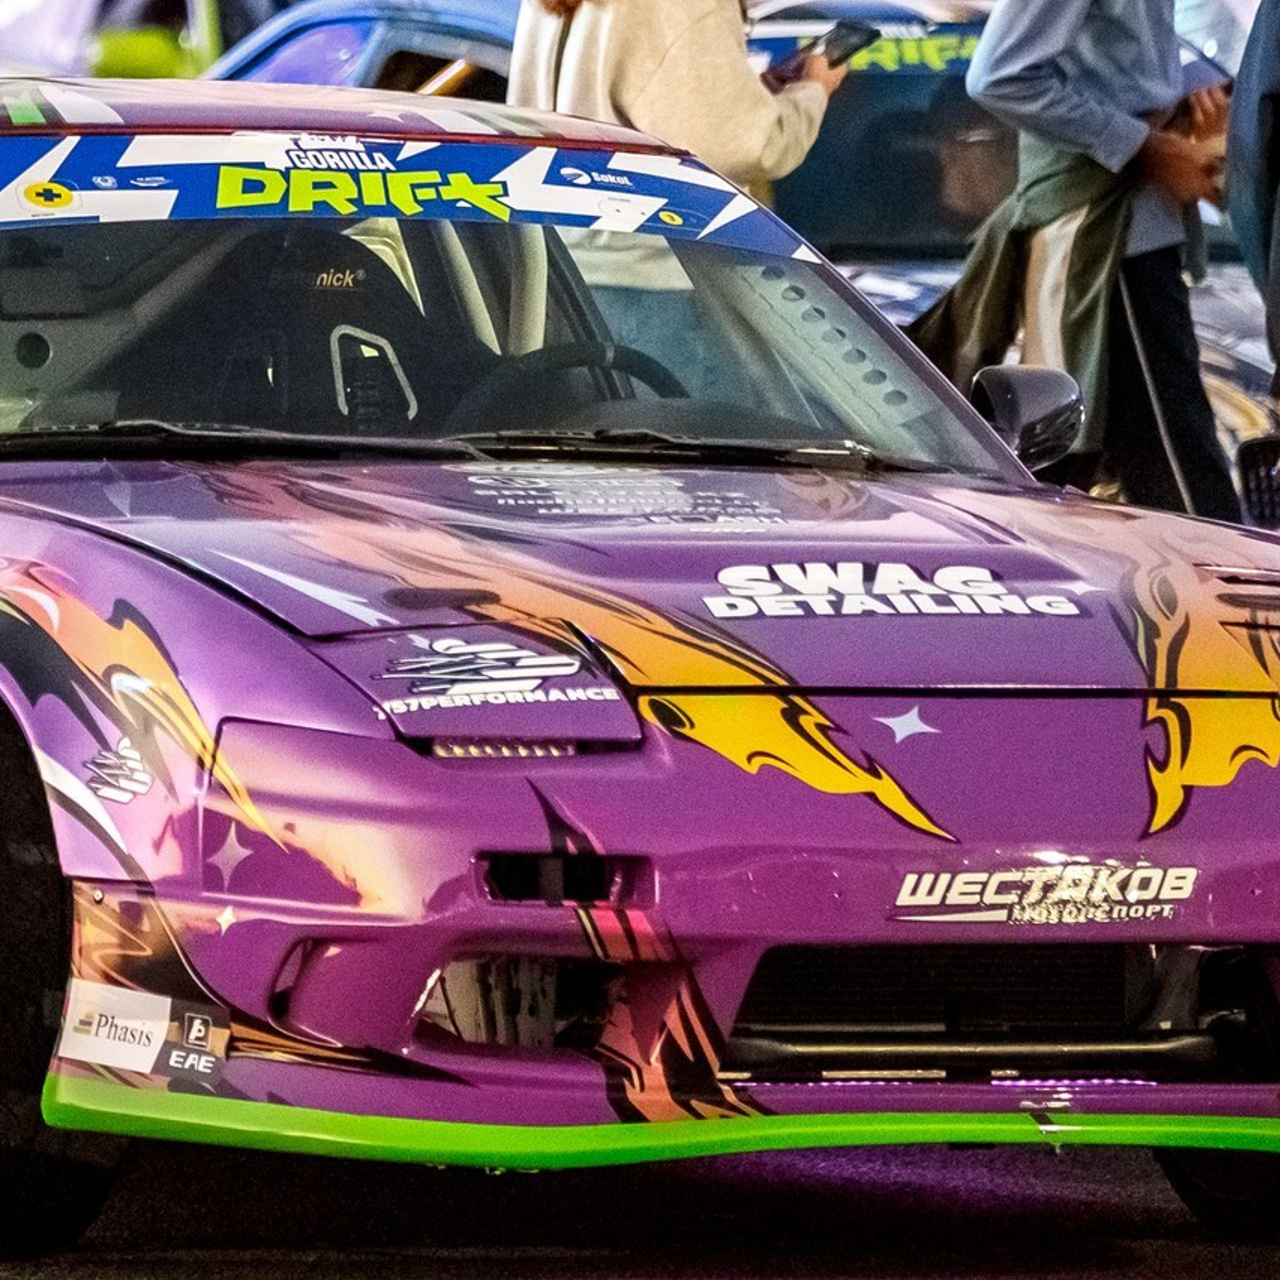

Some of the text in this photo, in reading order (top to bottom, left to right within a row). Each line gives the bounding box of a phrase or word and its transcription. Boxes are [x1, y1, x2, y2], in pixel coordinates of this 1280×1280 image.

[288, 150, 397, 171] GORILLA
[216, 165, 511, 222] DRIFT
[717, 562, 1009, 596] SWAG
[701, 592, 1081, 618] DETAILING
[894, 865, 1197, 907] ШЕСТАКОВ
[94, 1013, 154, 1048] Phasis
[169, 1050, 216, 1073] EAE
